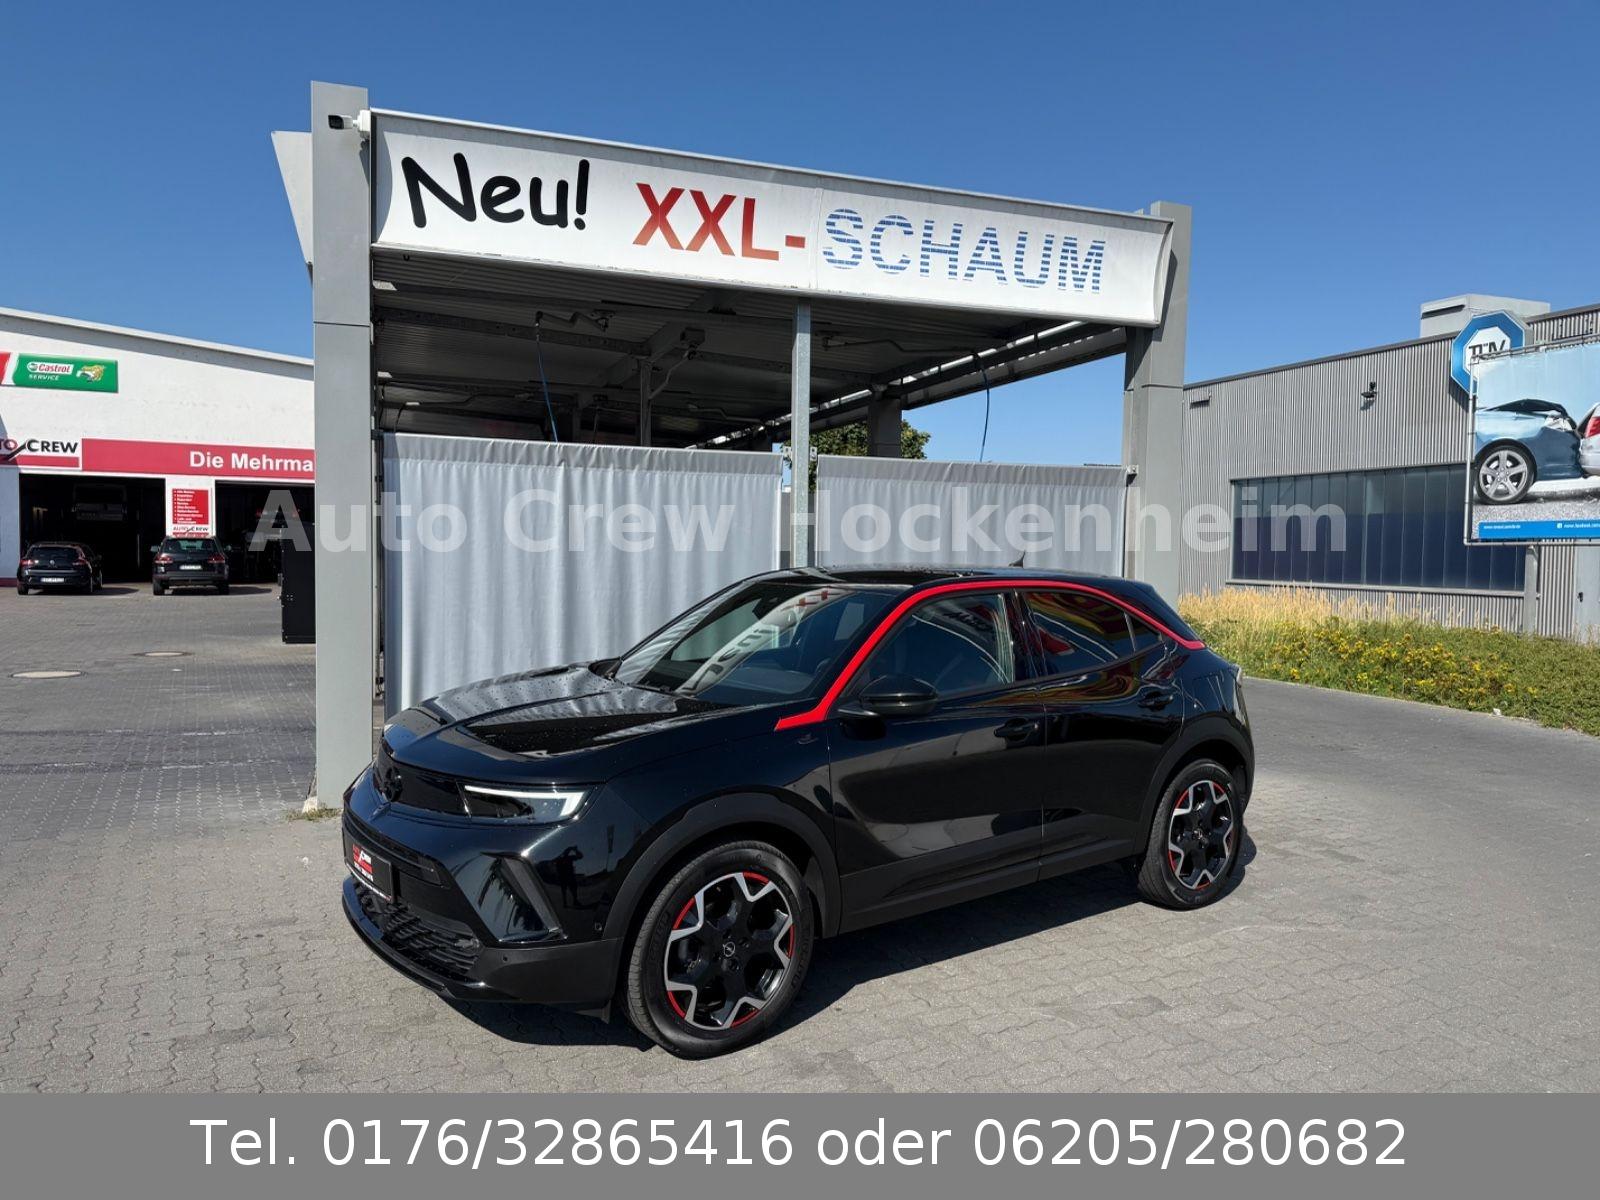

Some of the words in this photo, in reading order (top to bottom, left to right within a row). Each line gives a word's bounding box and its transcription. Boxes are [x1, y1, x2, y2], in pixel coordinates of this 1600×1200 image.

[401, 152, 591, 231] Neu!
[38, 363, 71, 373] Castrol
[27, 438, 79, 454] CREW
[189, 450, 225, 469] Die
[231, 453, 315, 473] Mehrma
